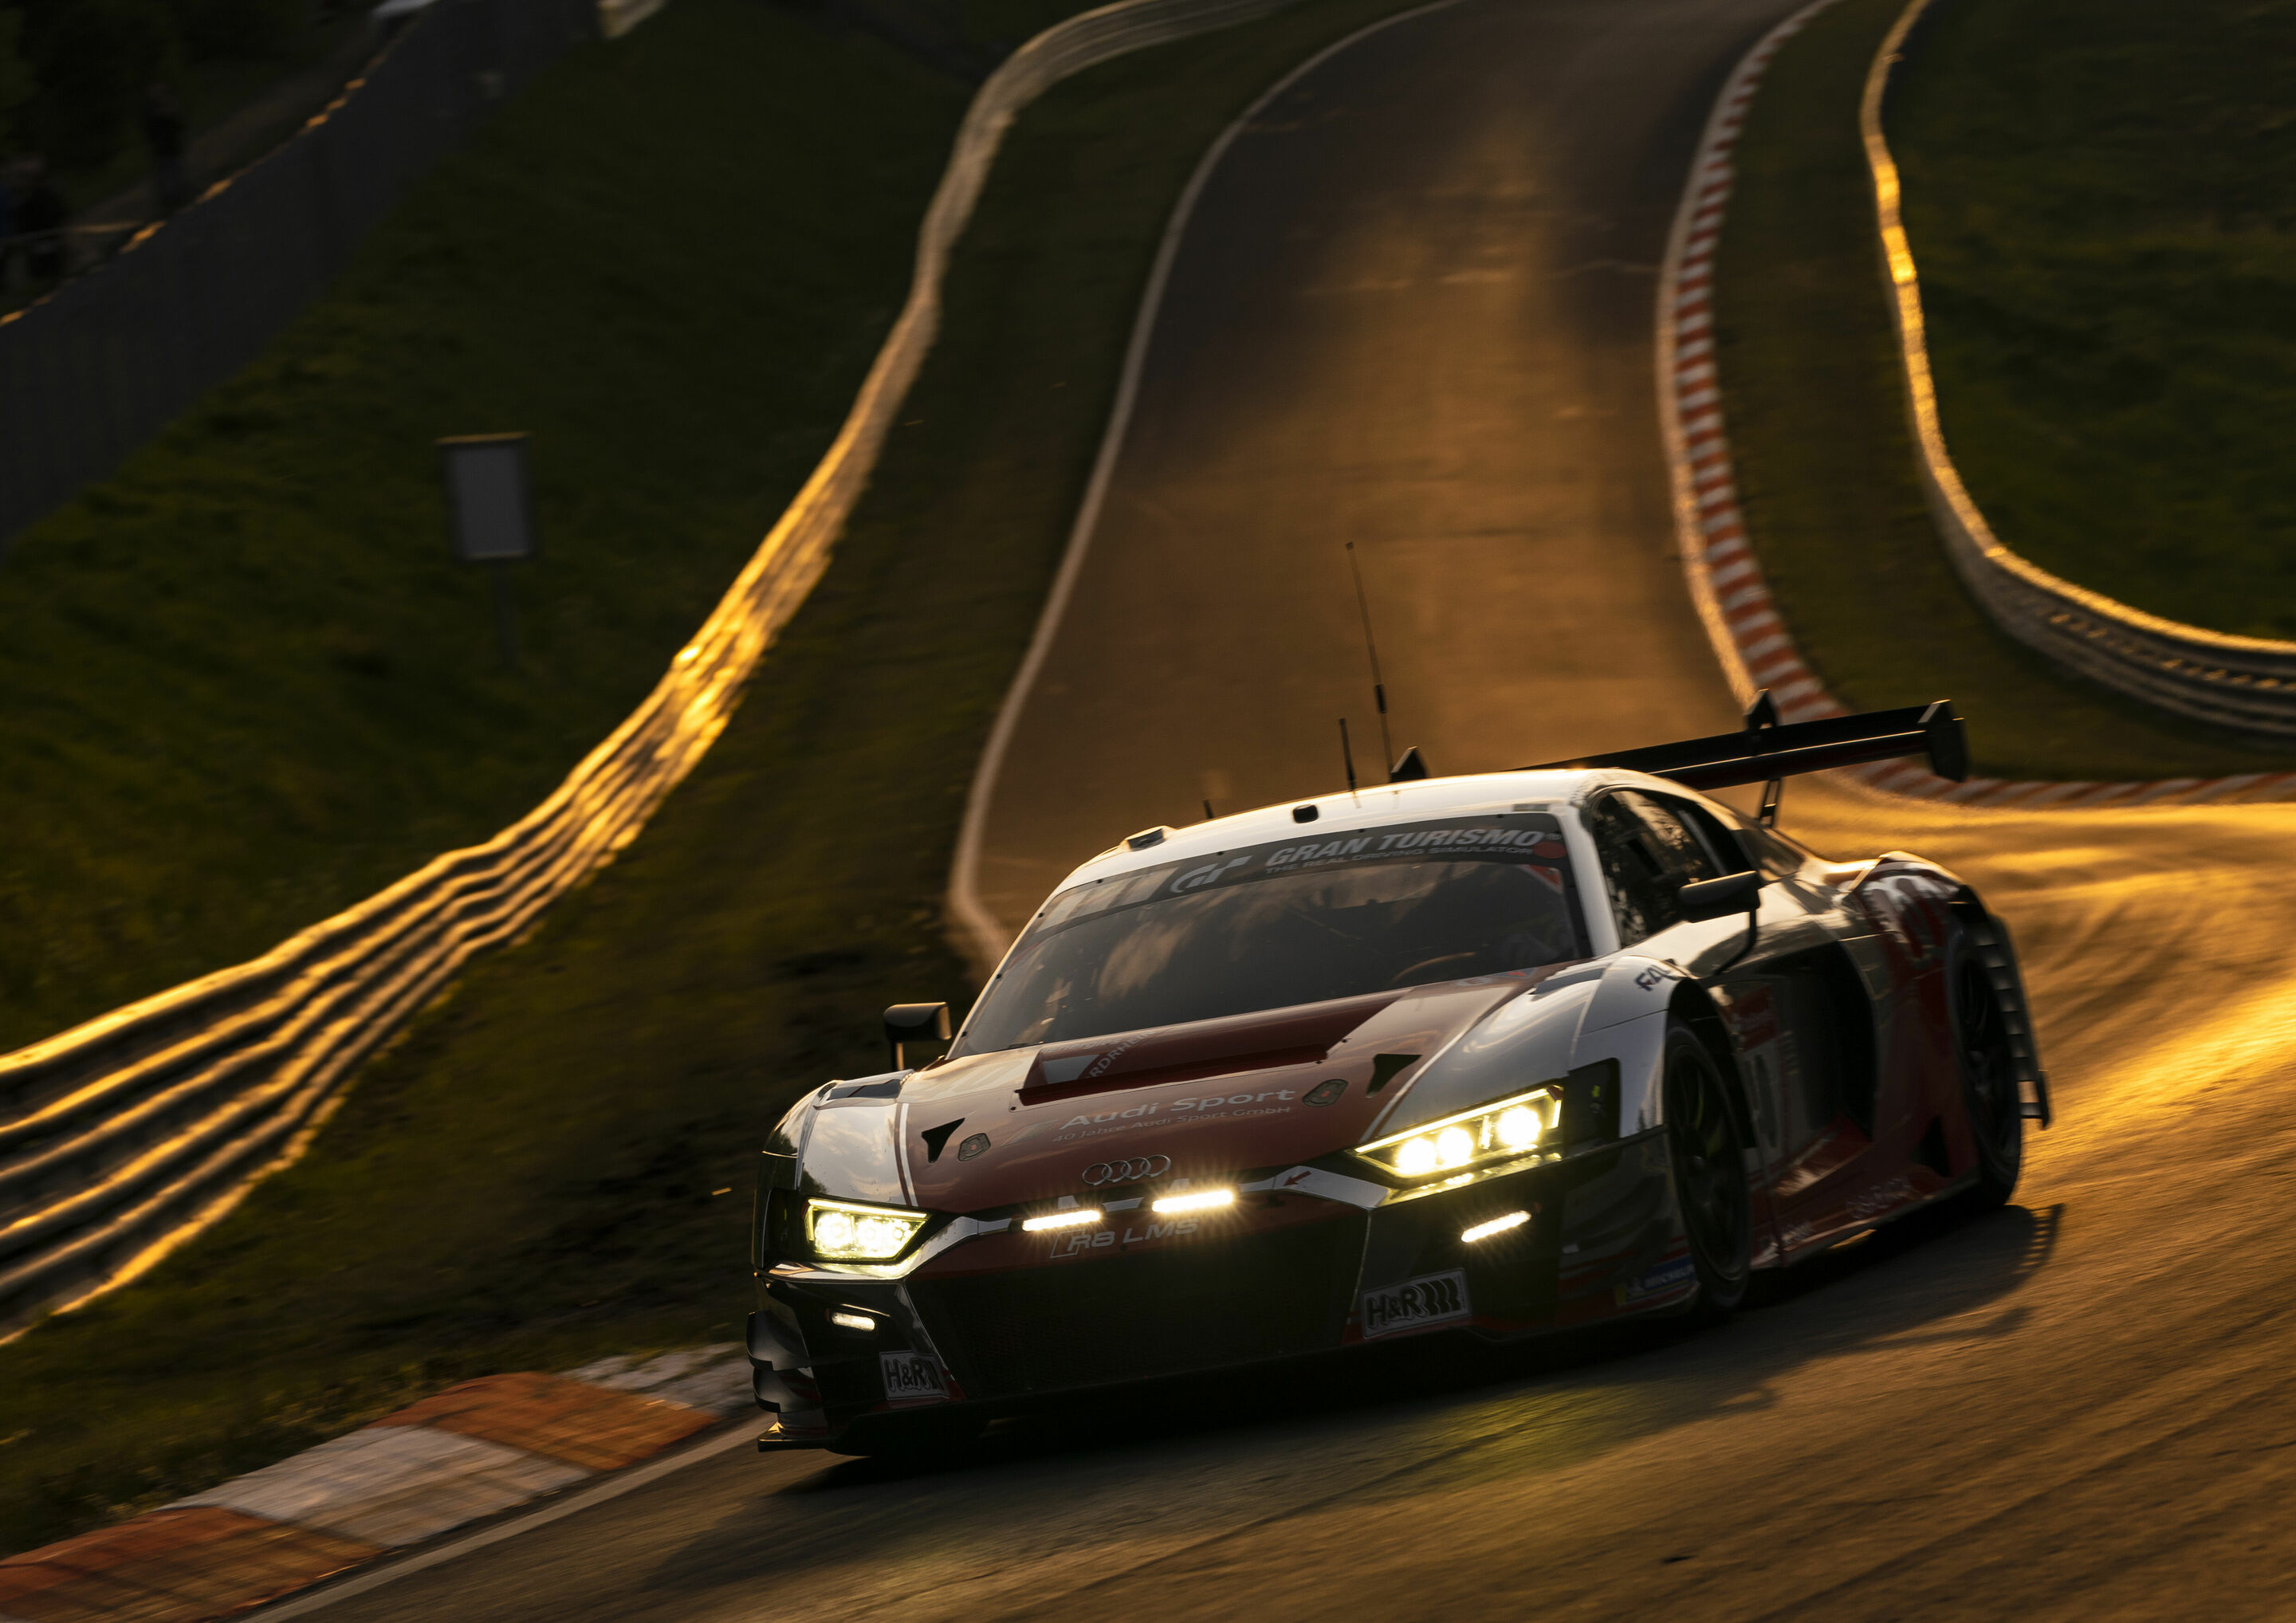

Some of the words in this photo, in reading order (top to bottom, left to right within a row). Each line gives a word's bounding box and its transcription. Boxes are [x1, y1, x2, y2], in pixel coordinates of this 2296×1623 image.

[1265, 837, 1373, 867] GRAN
[1377, 828, 1545, 851] TURISMO
[1265, 863, 1300, 874] THE
[1302, 857, 1349, 868] REAL
[1352, 847, 1425, 861] DRIVING
[1429, 845, 1533, 855] SIMULATOR
[1052, 1132, 1076, 1142] 40
[1077, 1125, 1126, 1139] Jahre
[1130, 1118, 1172, 1130] Audi
[1178, 1113, 1227, 1125] Sport
[1232, 1106, 1292, 1118] GmbH
[1059, 1102, 1159, 1130] Audi
[1170, 1089, 1295, 1111] Sport
[1066, 1231, 1116, 1252] R8
[1122, 1219, 1200, 1244] LMS
[1366, 1287, 1427, 1327] H&R
[884, 1358, 932, 1392] H&R
